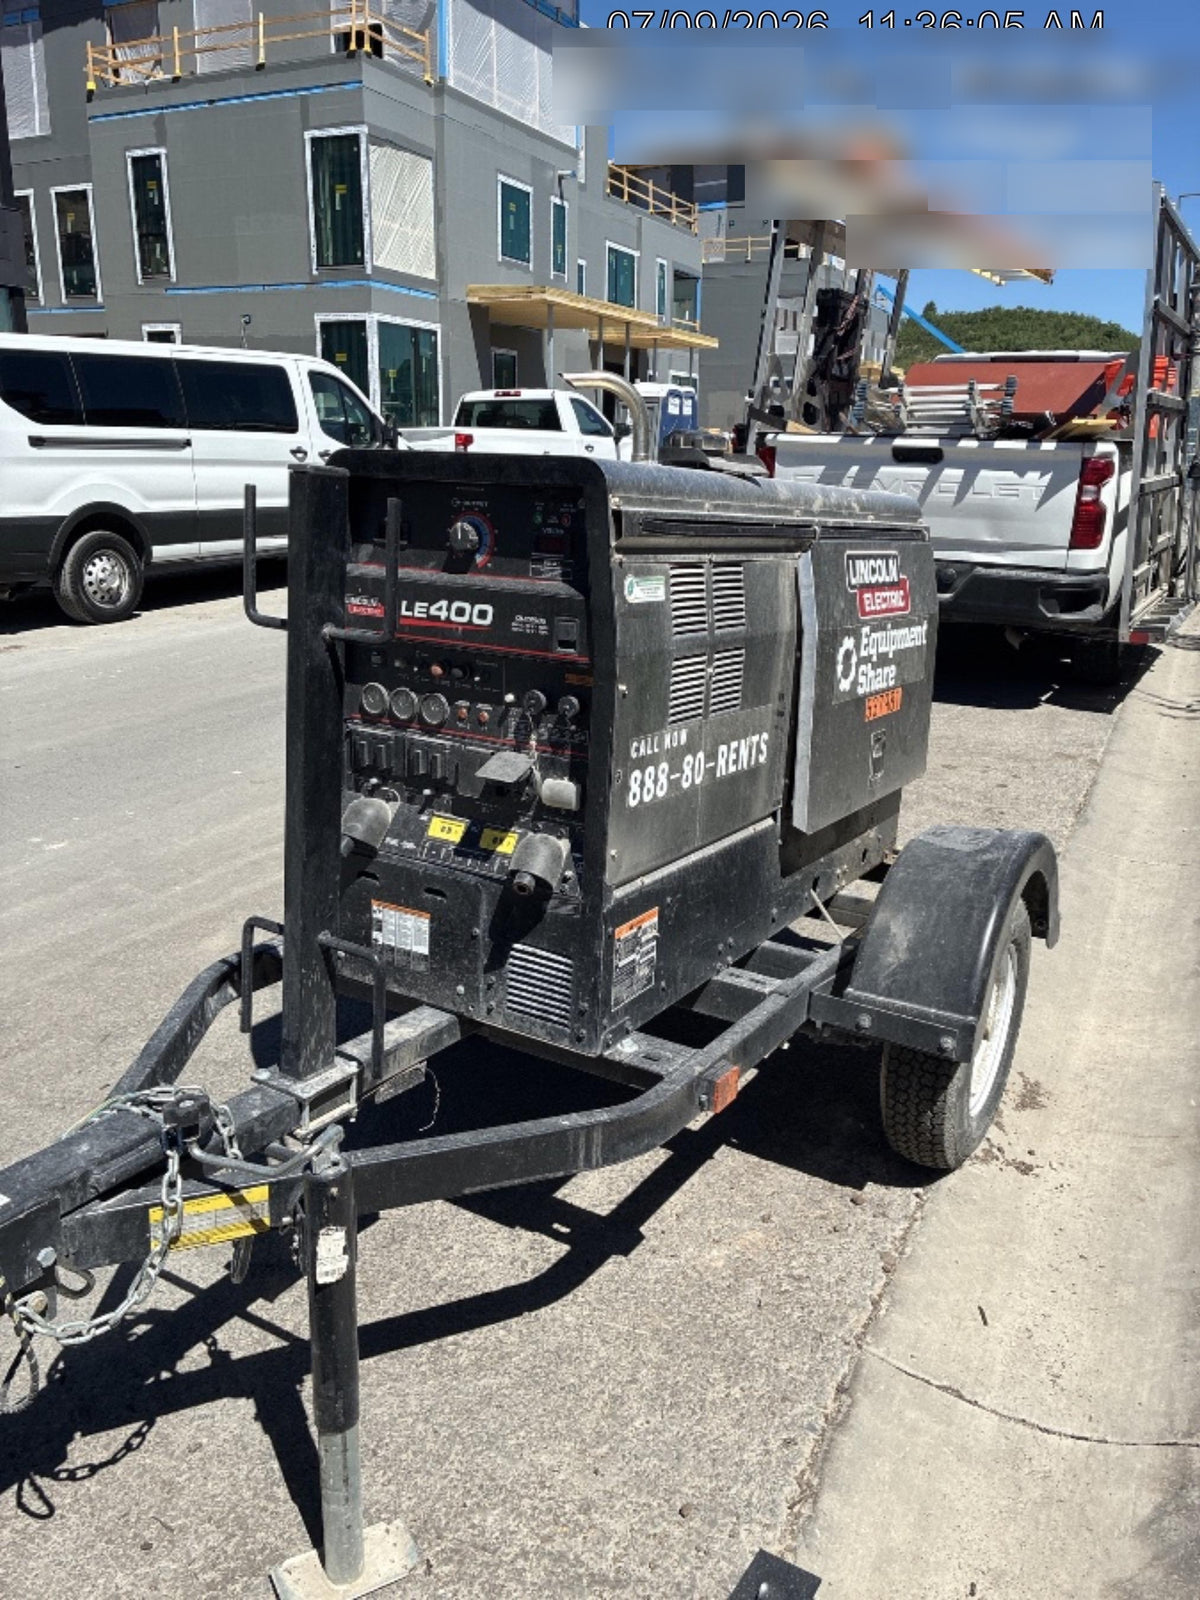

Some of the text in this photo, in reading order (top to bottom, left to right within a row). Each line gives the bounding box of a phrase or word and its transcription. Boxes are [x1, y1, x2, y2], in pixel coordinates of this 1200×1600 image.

[849, 555, 898, 586] LINCOLN
[400, 599, 494, 626] LE400
[862, 590, 906, 612] ELECTRIC
[859, 622, 928, 661] Equipment
[856, 662, 897, 695] Share
[630, 728, 688, 760] CALL NOW
[628, 731, 769, 808] 888-80-RENTS
